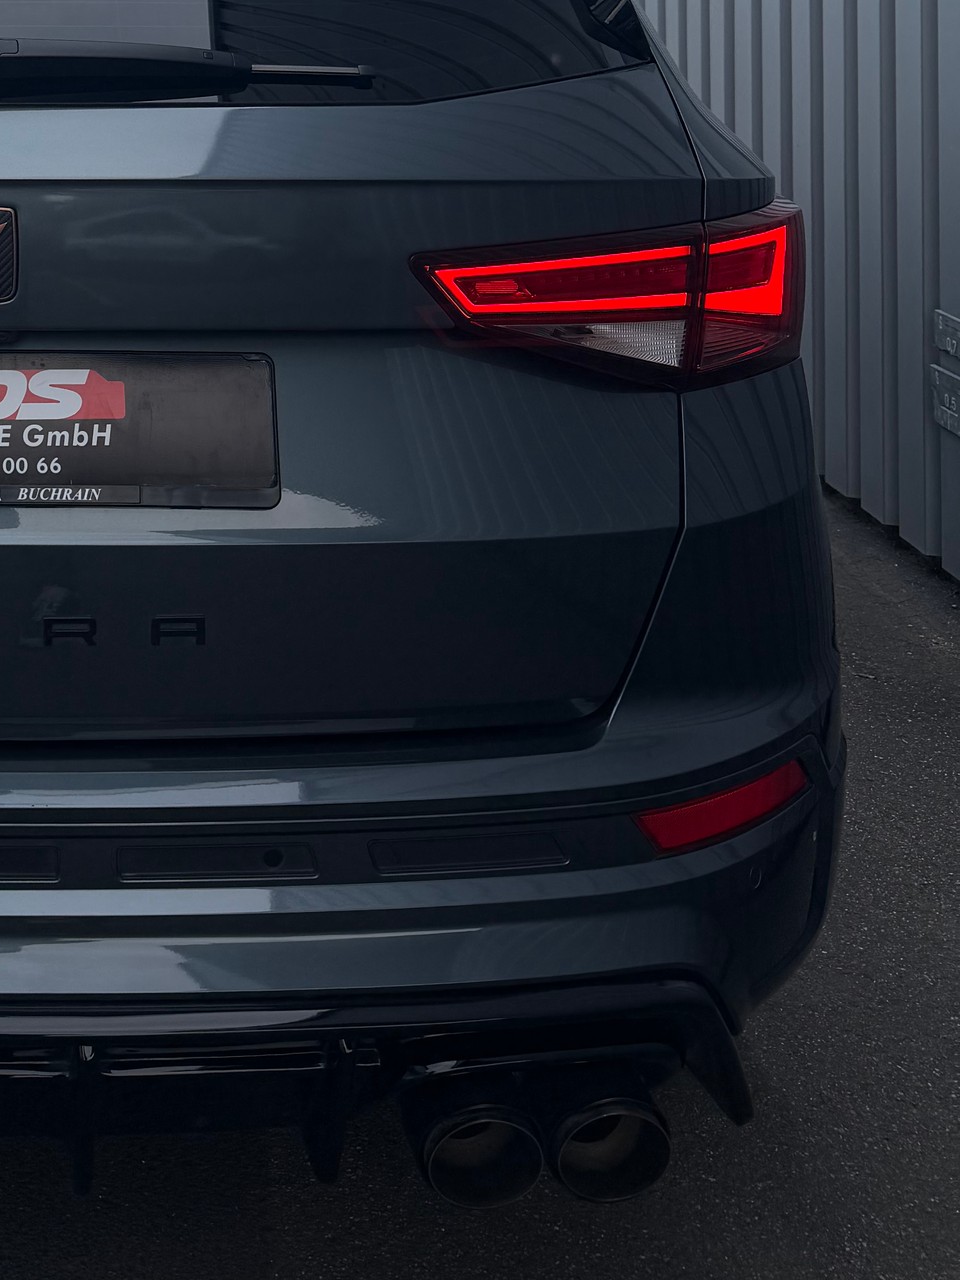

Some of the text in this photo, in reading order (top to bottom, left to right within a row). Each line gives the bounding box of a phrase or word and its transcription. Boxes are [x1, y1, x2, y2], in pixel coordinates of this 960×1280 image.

[22, 423, 112, 447] GmbH
[2, 457, 29, 474] 00
[36, 457, 62, 474] 66
[16, 486, 102, 502] BUCHRAIN
